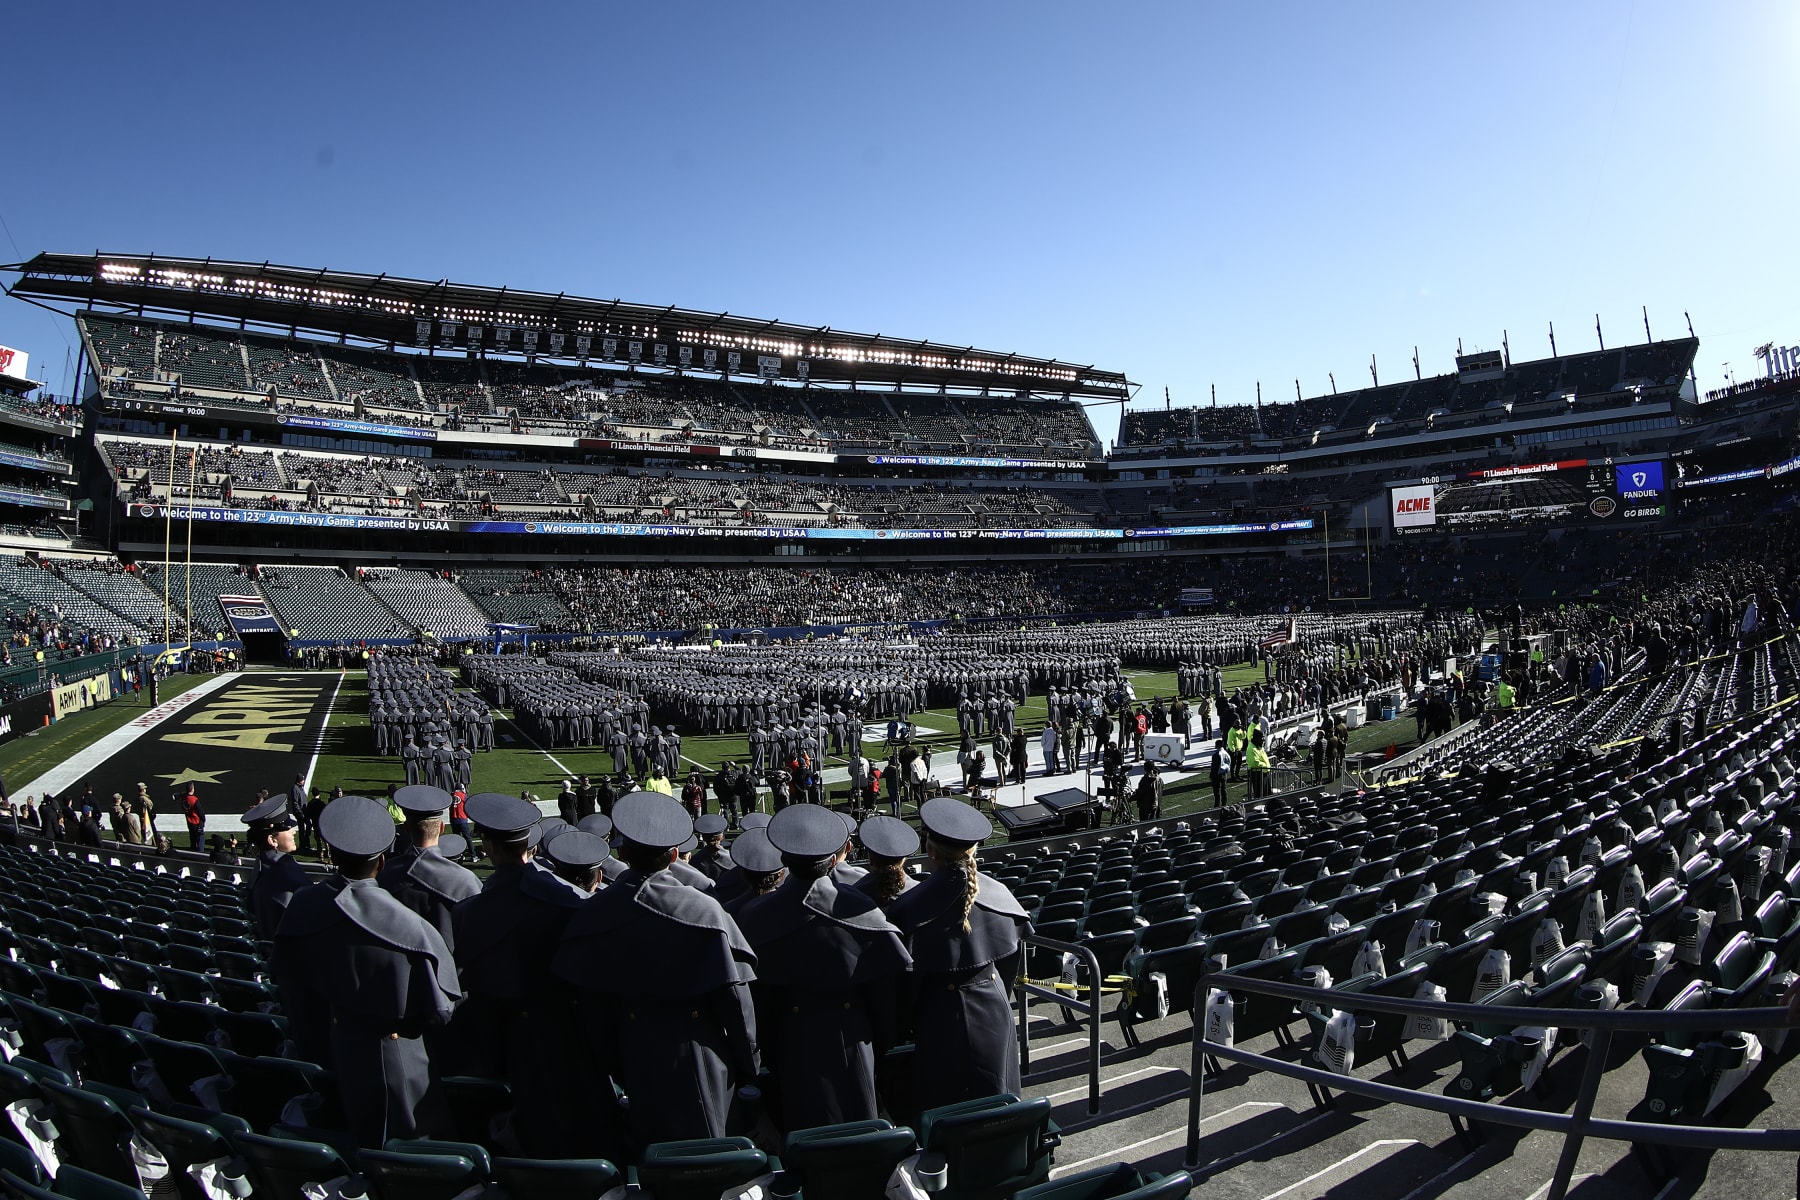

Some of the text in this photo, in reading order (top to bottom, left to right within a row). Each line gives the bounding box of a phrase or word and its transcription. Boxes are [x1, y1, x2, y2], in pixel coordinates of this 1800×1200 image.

[187, 407, 205, 416] 90:00
[289, 417, 314, 426] Welcome
[344, 423, 373, 432] Army-Navy
[388, 427, 414, 436] presented
[414, 429, 421, 437] by
[422, 430, 436, 438] USAA
[618, 441, 690, 453] Lincoln Financial Field
[736, 448, 756, 457] 90:00
[960, 459, 999, 467] Army-Navy
[1490, 463, 1558, 477] Lincoln Financial Field
[1421, 476, 1439, 485] 90:00
[1623, 489, 1658, 499] FANDUEL
[1397, 497, 1430, 513] ACME
[1624, 507, 1660, 518] GO BIRDS
[160, 507, 450, 531] Welcome to the 123rd Army-Navy Game presented by USAA
[543, 524, 806, 538] Welcome to the 123rd Army-Navy Game presented by USAA
[892, 530, 1115, 539] Welcome to the 123rd Army-Navy Game presented by USAA
[59, 689, 77, 711] ARMY
[158, 684, 323, 752] ARMY
